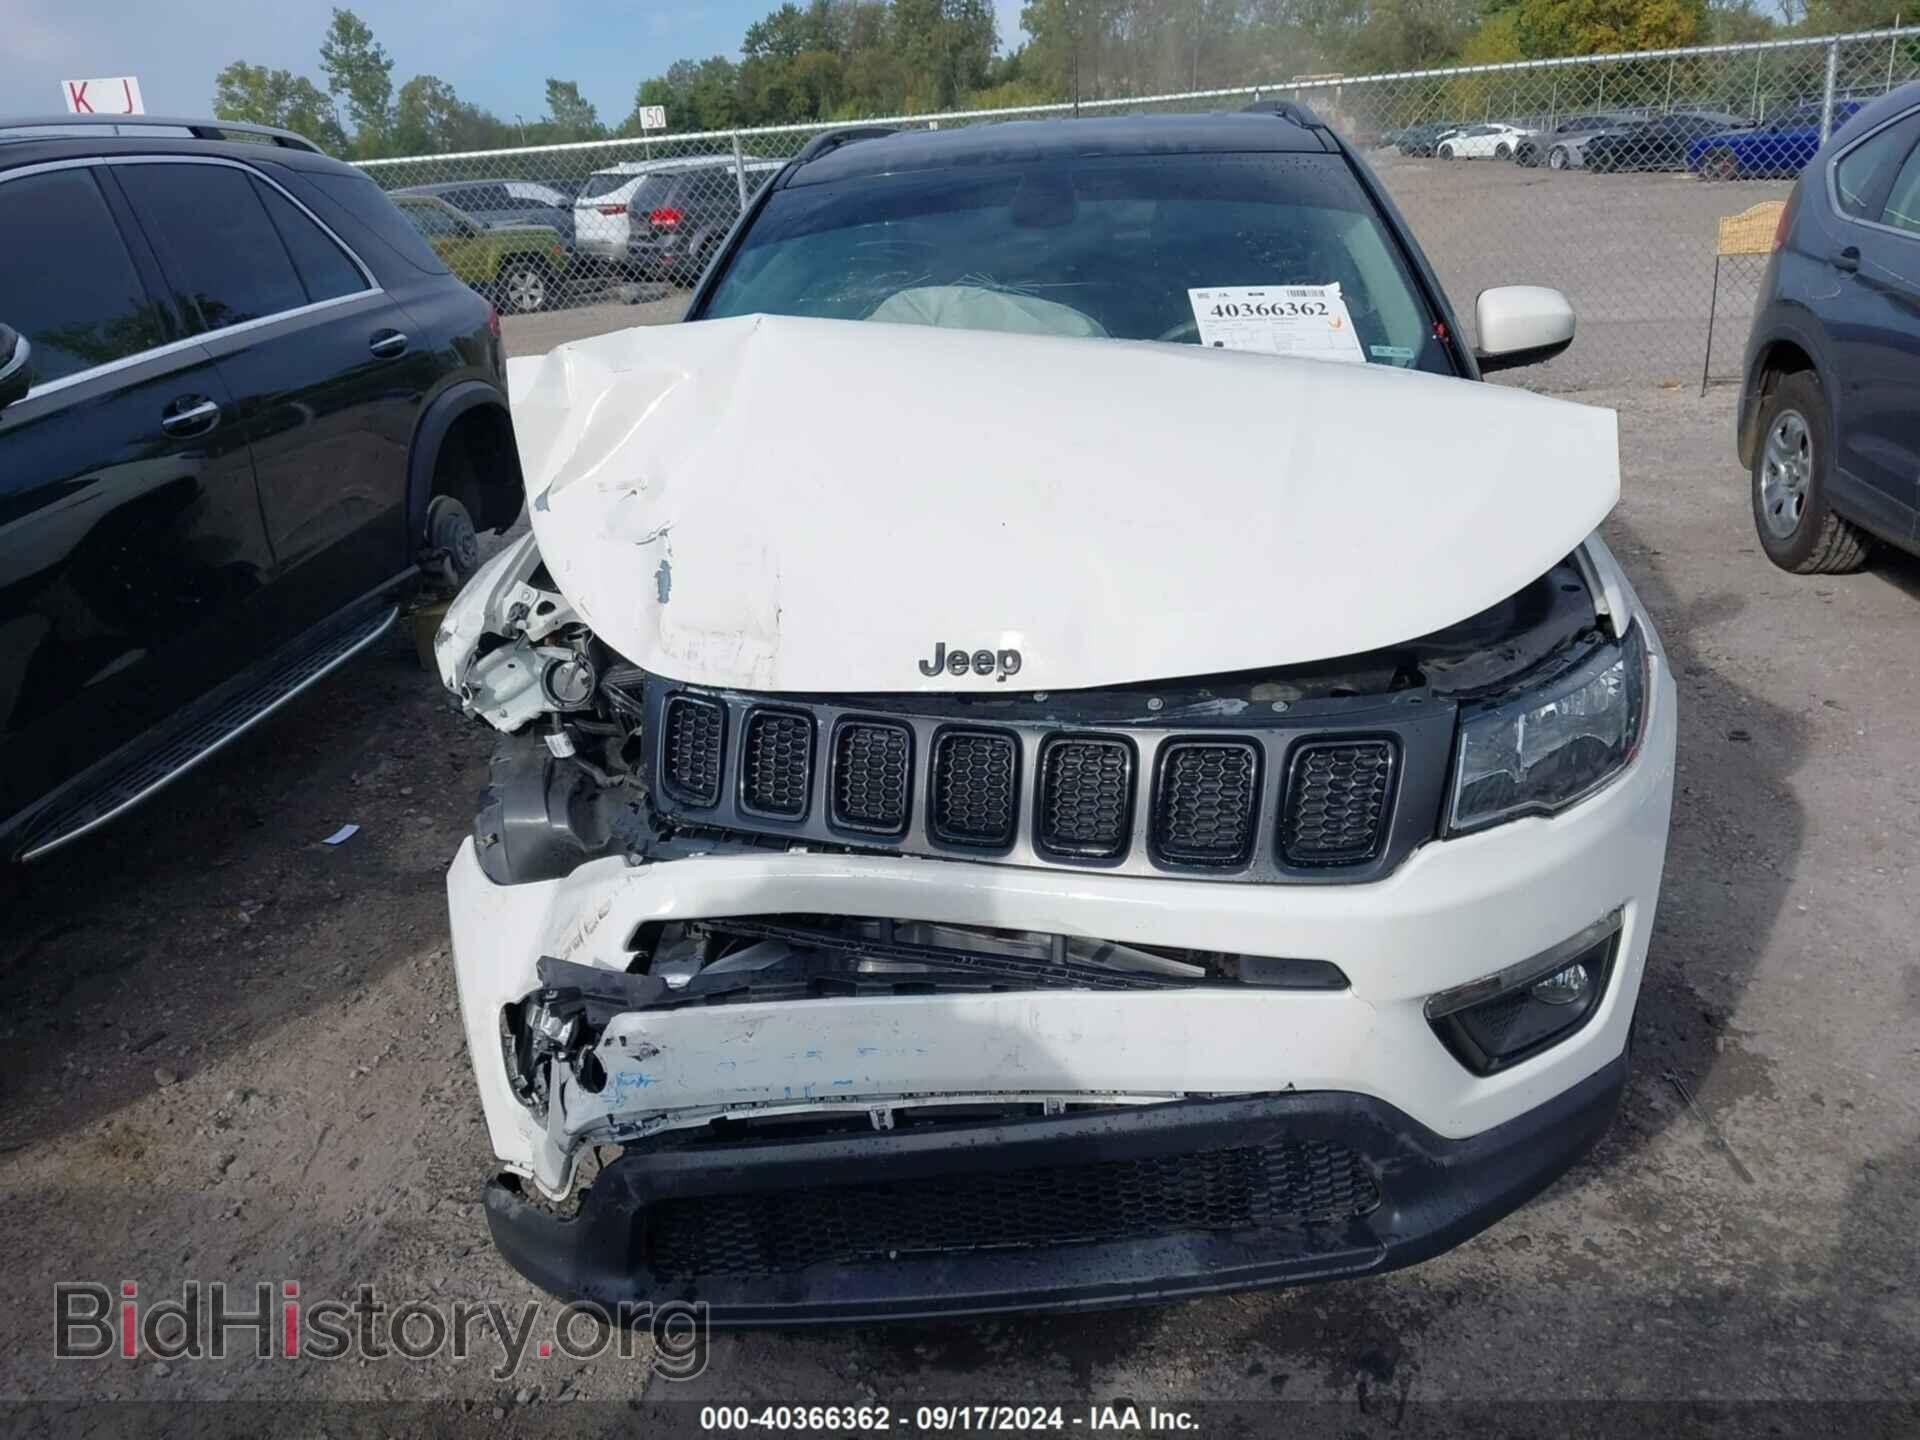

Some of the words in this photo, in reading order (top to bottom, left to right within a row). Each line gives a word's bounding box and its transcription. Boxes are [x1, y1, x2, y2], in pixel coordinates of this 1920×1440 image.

[69, 81, 94, 113] K
[123, 79, 133, 114] J
[1211, 302, 1329, 318] 40366362
[919, 642, 1022, 682] Jeep
